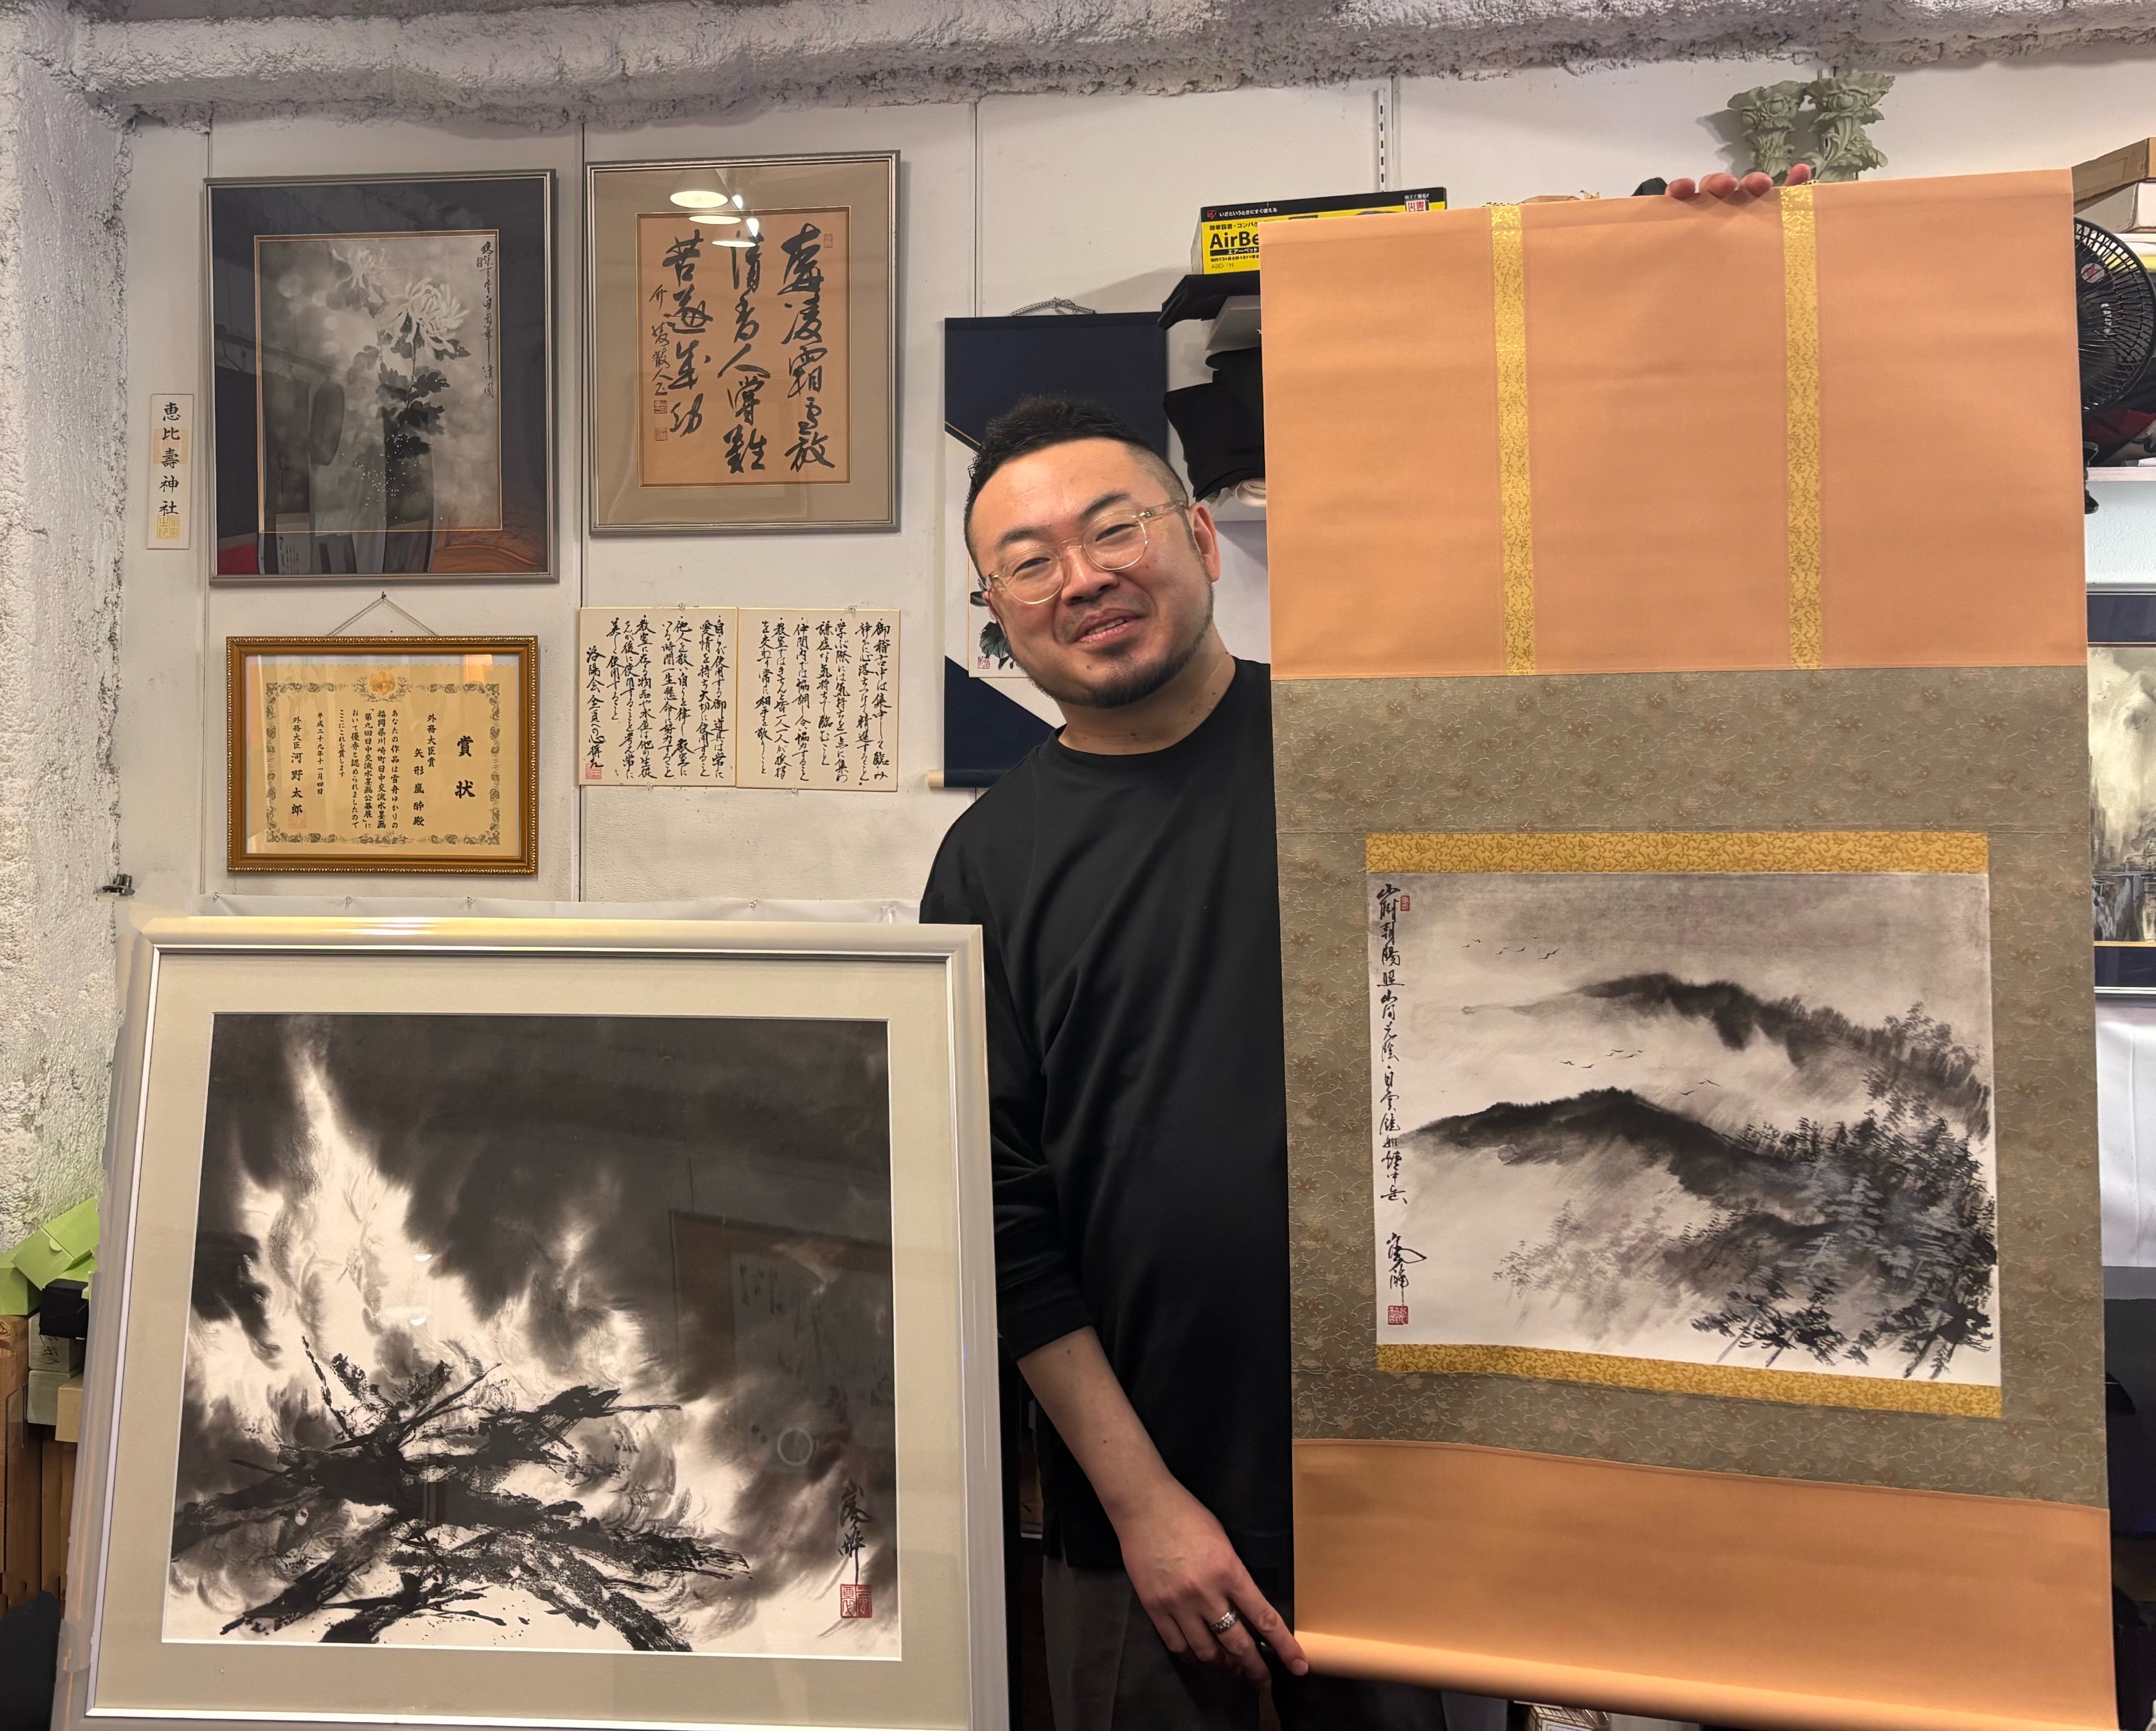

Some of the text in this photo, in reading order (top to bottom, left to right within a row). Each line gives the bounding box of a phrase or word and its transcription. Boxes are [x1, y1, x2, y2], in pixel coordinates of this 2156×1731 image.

[1209, 231, 1259, 249] AirBe
[351, 709, 360, 828] おいて優秀と認められましたので
[377, 710, 386, 828] 福岡県川崎町日中交流水墨画
[390, 710, 400, 828] あなたの作品は雪舟ゆかりの
[427, 713, 436, 767] 外務大臣賞
